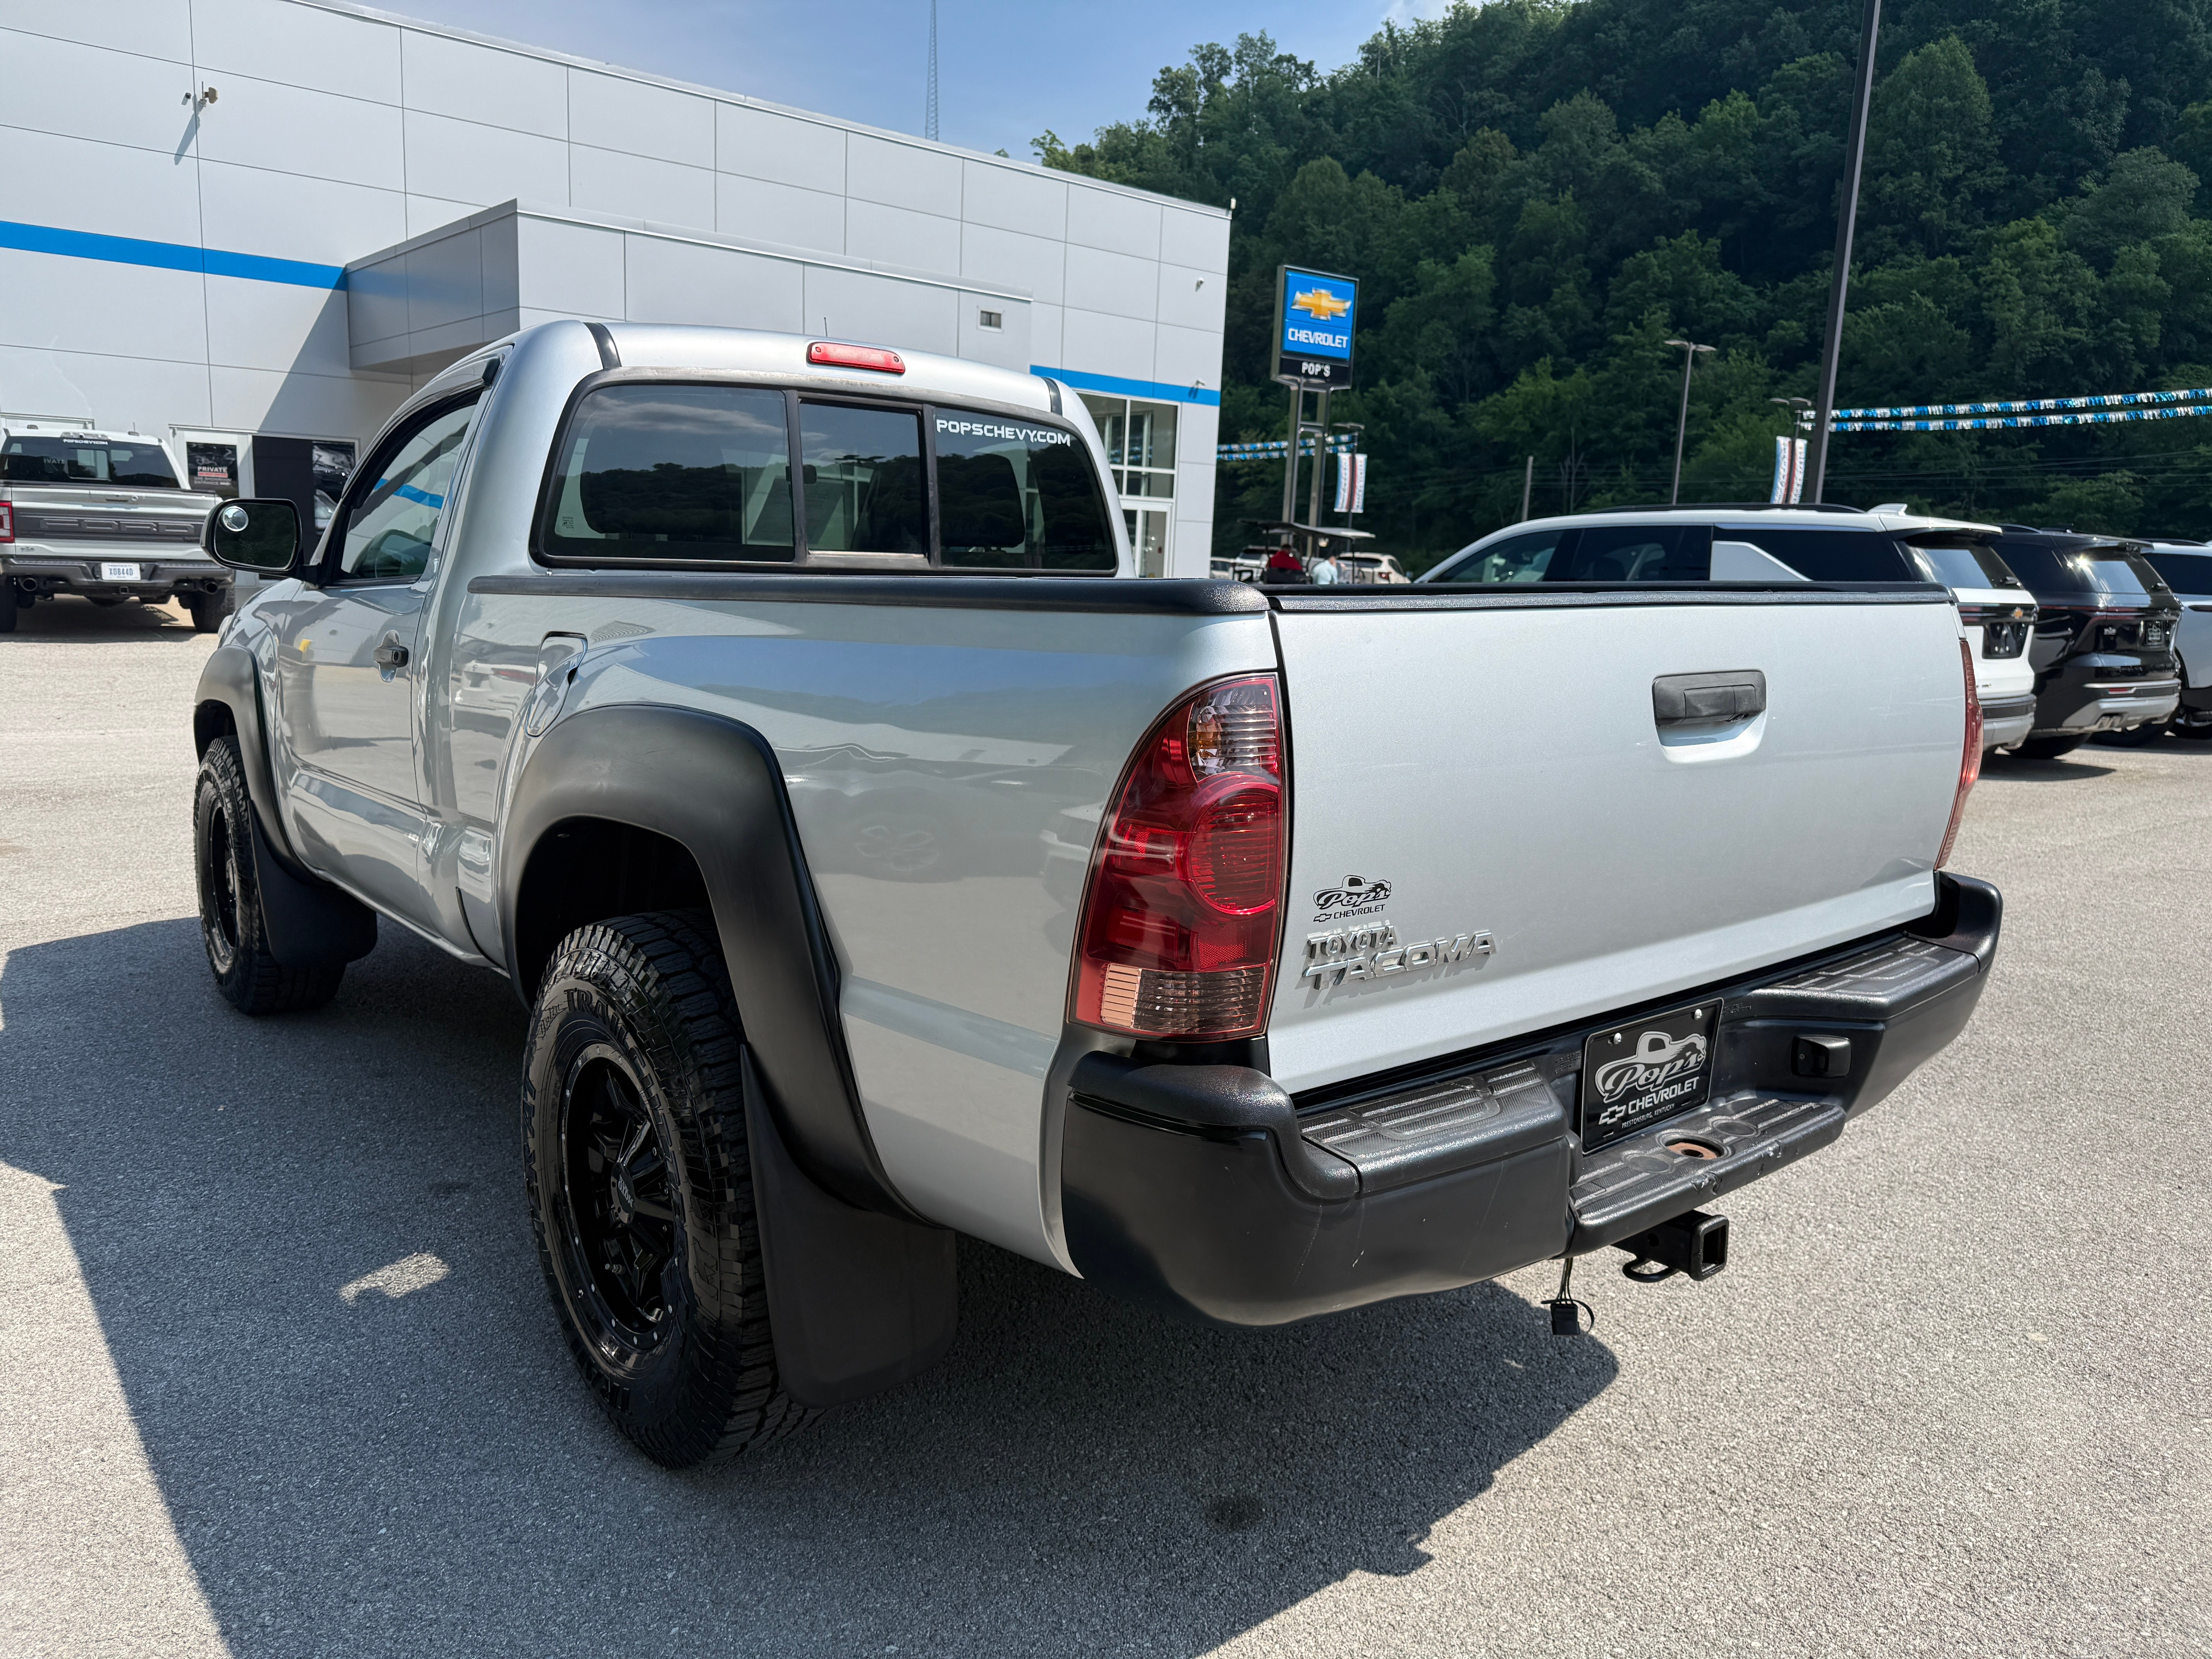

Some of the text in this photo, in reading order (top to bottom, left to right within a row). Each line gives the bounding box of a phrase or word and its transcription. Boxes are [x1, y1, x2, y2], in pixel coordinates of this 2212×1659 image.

[1288, 328, 1348, 348] CHEVROLET
[1302, 361, 1331, 377] POP'S
[936, 419, 1070, 447] POPSCHEVY.COM
[40, 518, 194, 534] FORD
[1334, 904, 1385, 919] CHEVROLET
[1308, 925, 1398, 959] TOYOTA
[1302, 932, 1497, 990] TACOMA
[1628, 1077, 1699, 1114] CHEVROLET
[1654, 1103, 1675, 1116] KENTUCKY
